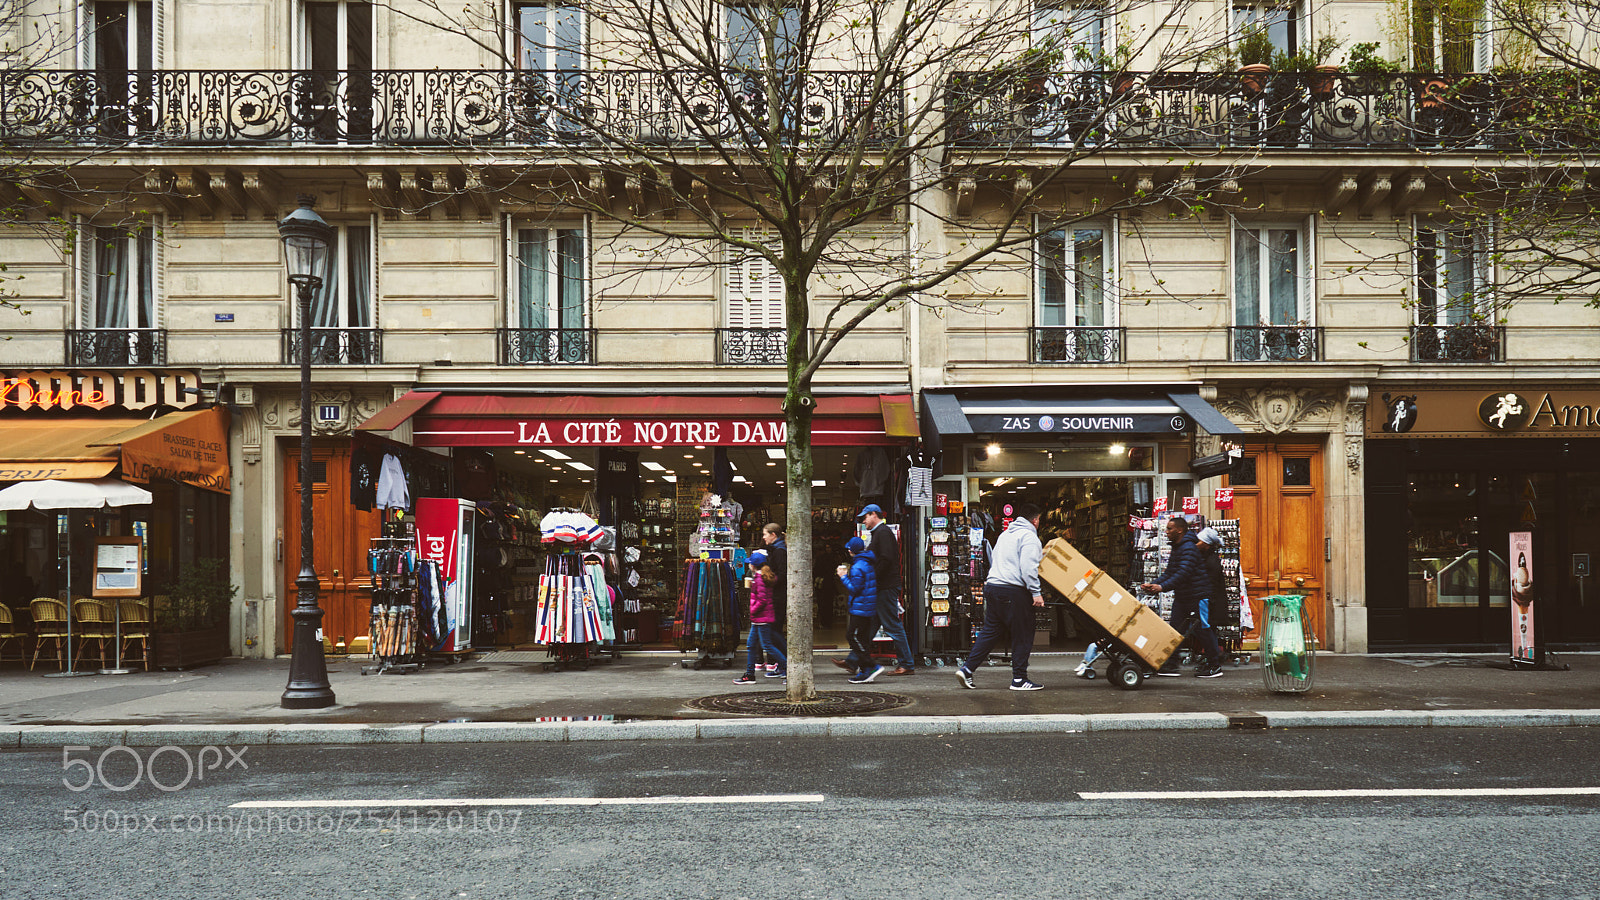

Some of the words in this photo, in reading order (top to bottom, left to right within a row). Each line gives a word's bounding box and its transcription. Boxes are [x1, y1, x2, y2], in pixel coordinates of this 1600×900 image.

[325, 407, 334, 419] 11
[1272, 404, 1283, 413] 13
[1003, 417, 1031, 430] ZAS
[1062, 417, 1134, 430] SOUVENIR
[1174, 419, 1182, 427] 13
[518, 422, 553, 443] LA
[563, 418, 622, 443] CITÉ
[633, 422, 721, 443] NOTRE
[732, 422, 788, 443] DAM
[163, 433, 196, 448] BRASSERIE
[198, 440, 222, 452] GLACES
[169, 447, 192, 458] SALON
[193, 450, 203, 461] DE
[131, 462, 151, 480] LE
[608, 461, 627, 472] PARIS
